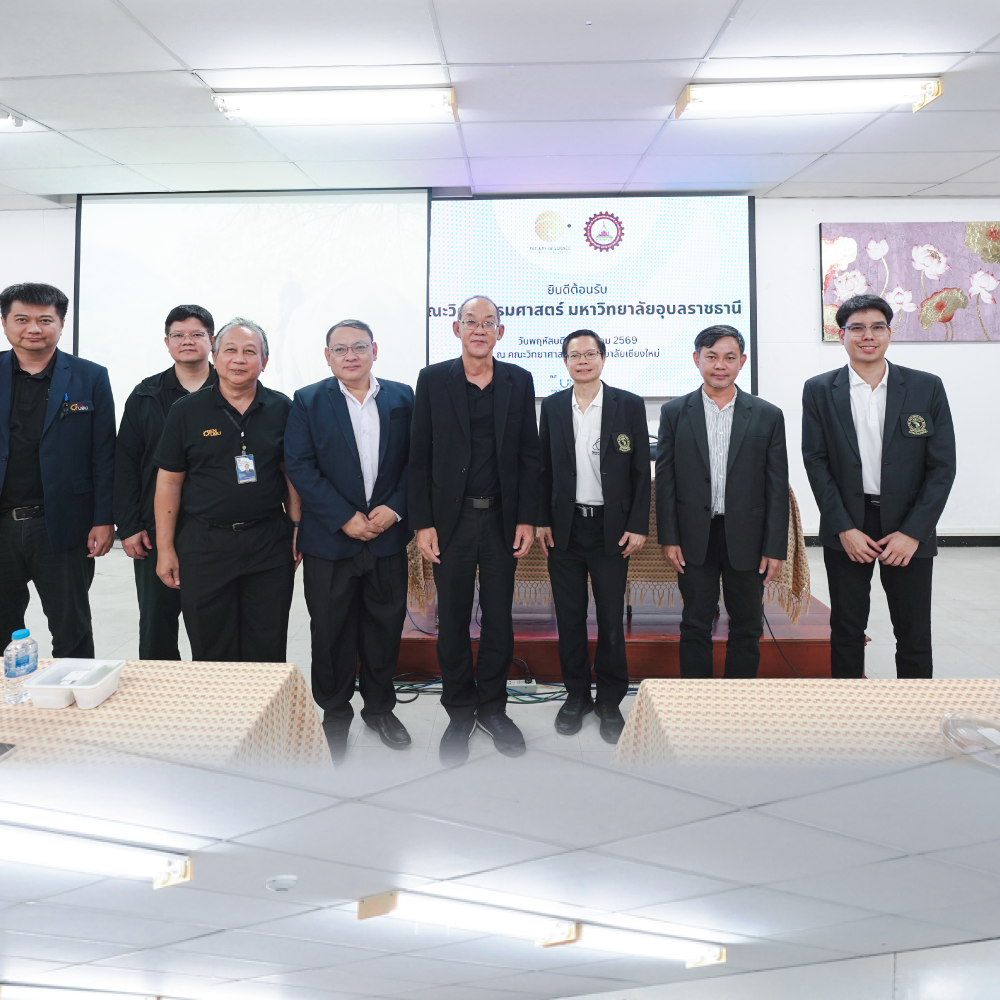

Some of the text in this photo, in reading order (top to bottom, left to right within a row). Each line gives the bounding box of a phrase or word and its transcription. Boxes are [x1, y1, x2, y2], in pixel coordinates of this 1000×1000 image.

[547, 283, 608, 295] ยินดีต้อนรับ
[568, 299, 742, 319] มหาวิทยาลัยอุบลราชธานี
[613, 336, 637, 344] 2569
